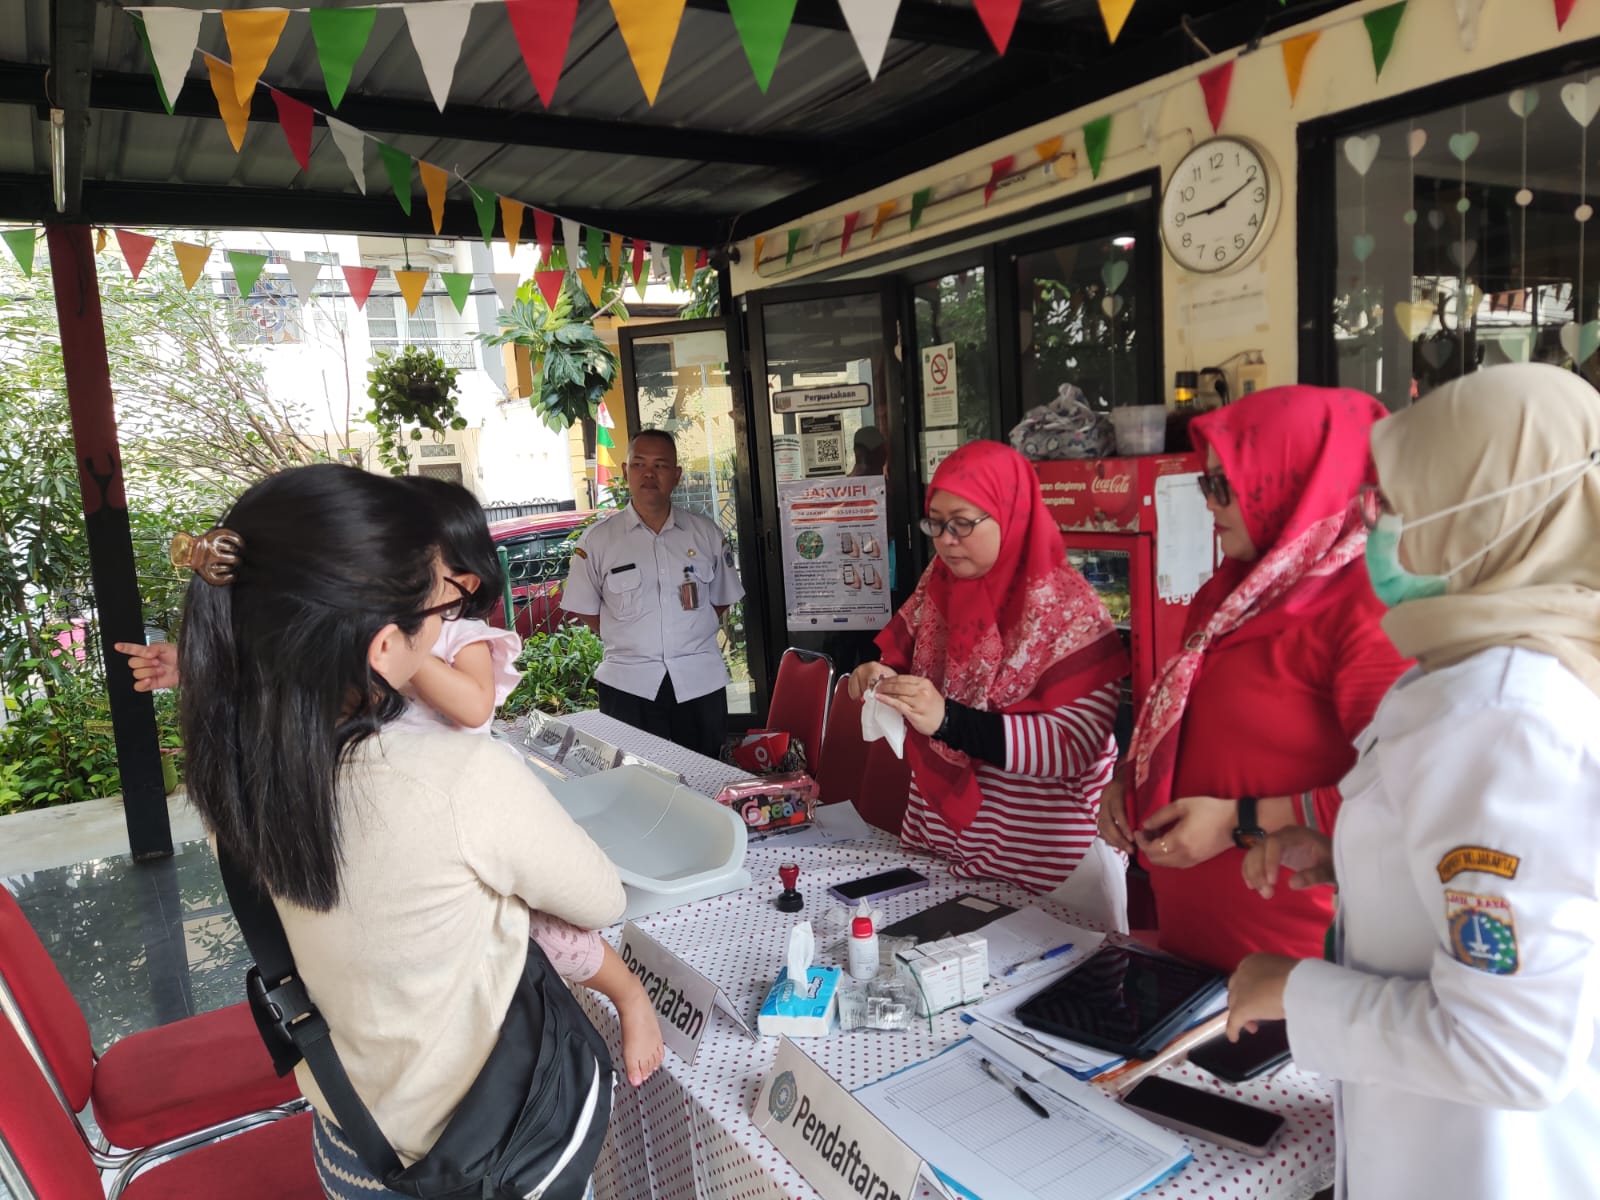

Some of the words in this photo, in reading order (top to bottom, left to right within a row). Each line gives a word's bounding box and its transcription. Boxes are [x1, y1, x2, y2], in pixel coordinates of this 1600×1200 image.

[1208, 152, 1225, 170] 12
[1192, 167, 1202, 181] 11
[1246, 165, 1257, 180] 2
[1179, 186, 1196, 203] 10
[1253, 186, 1265, 203] 3
[1175, 211, 1187, 228] 9
[1247, 213, 1259, 229] 4
[1181, 232, 1193, 248] 8
[1234, 233, 1245, 249] 5
[1197, 243, 1206, 259] 7
[1214, 246, 1227, 262] 6
[804, 390, 857, 402] Perpustakaan
[621, 942, 704, 1041] Pencatatan
